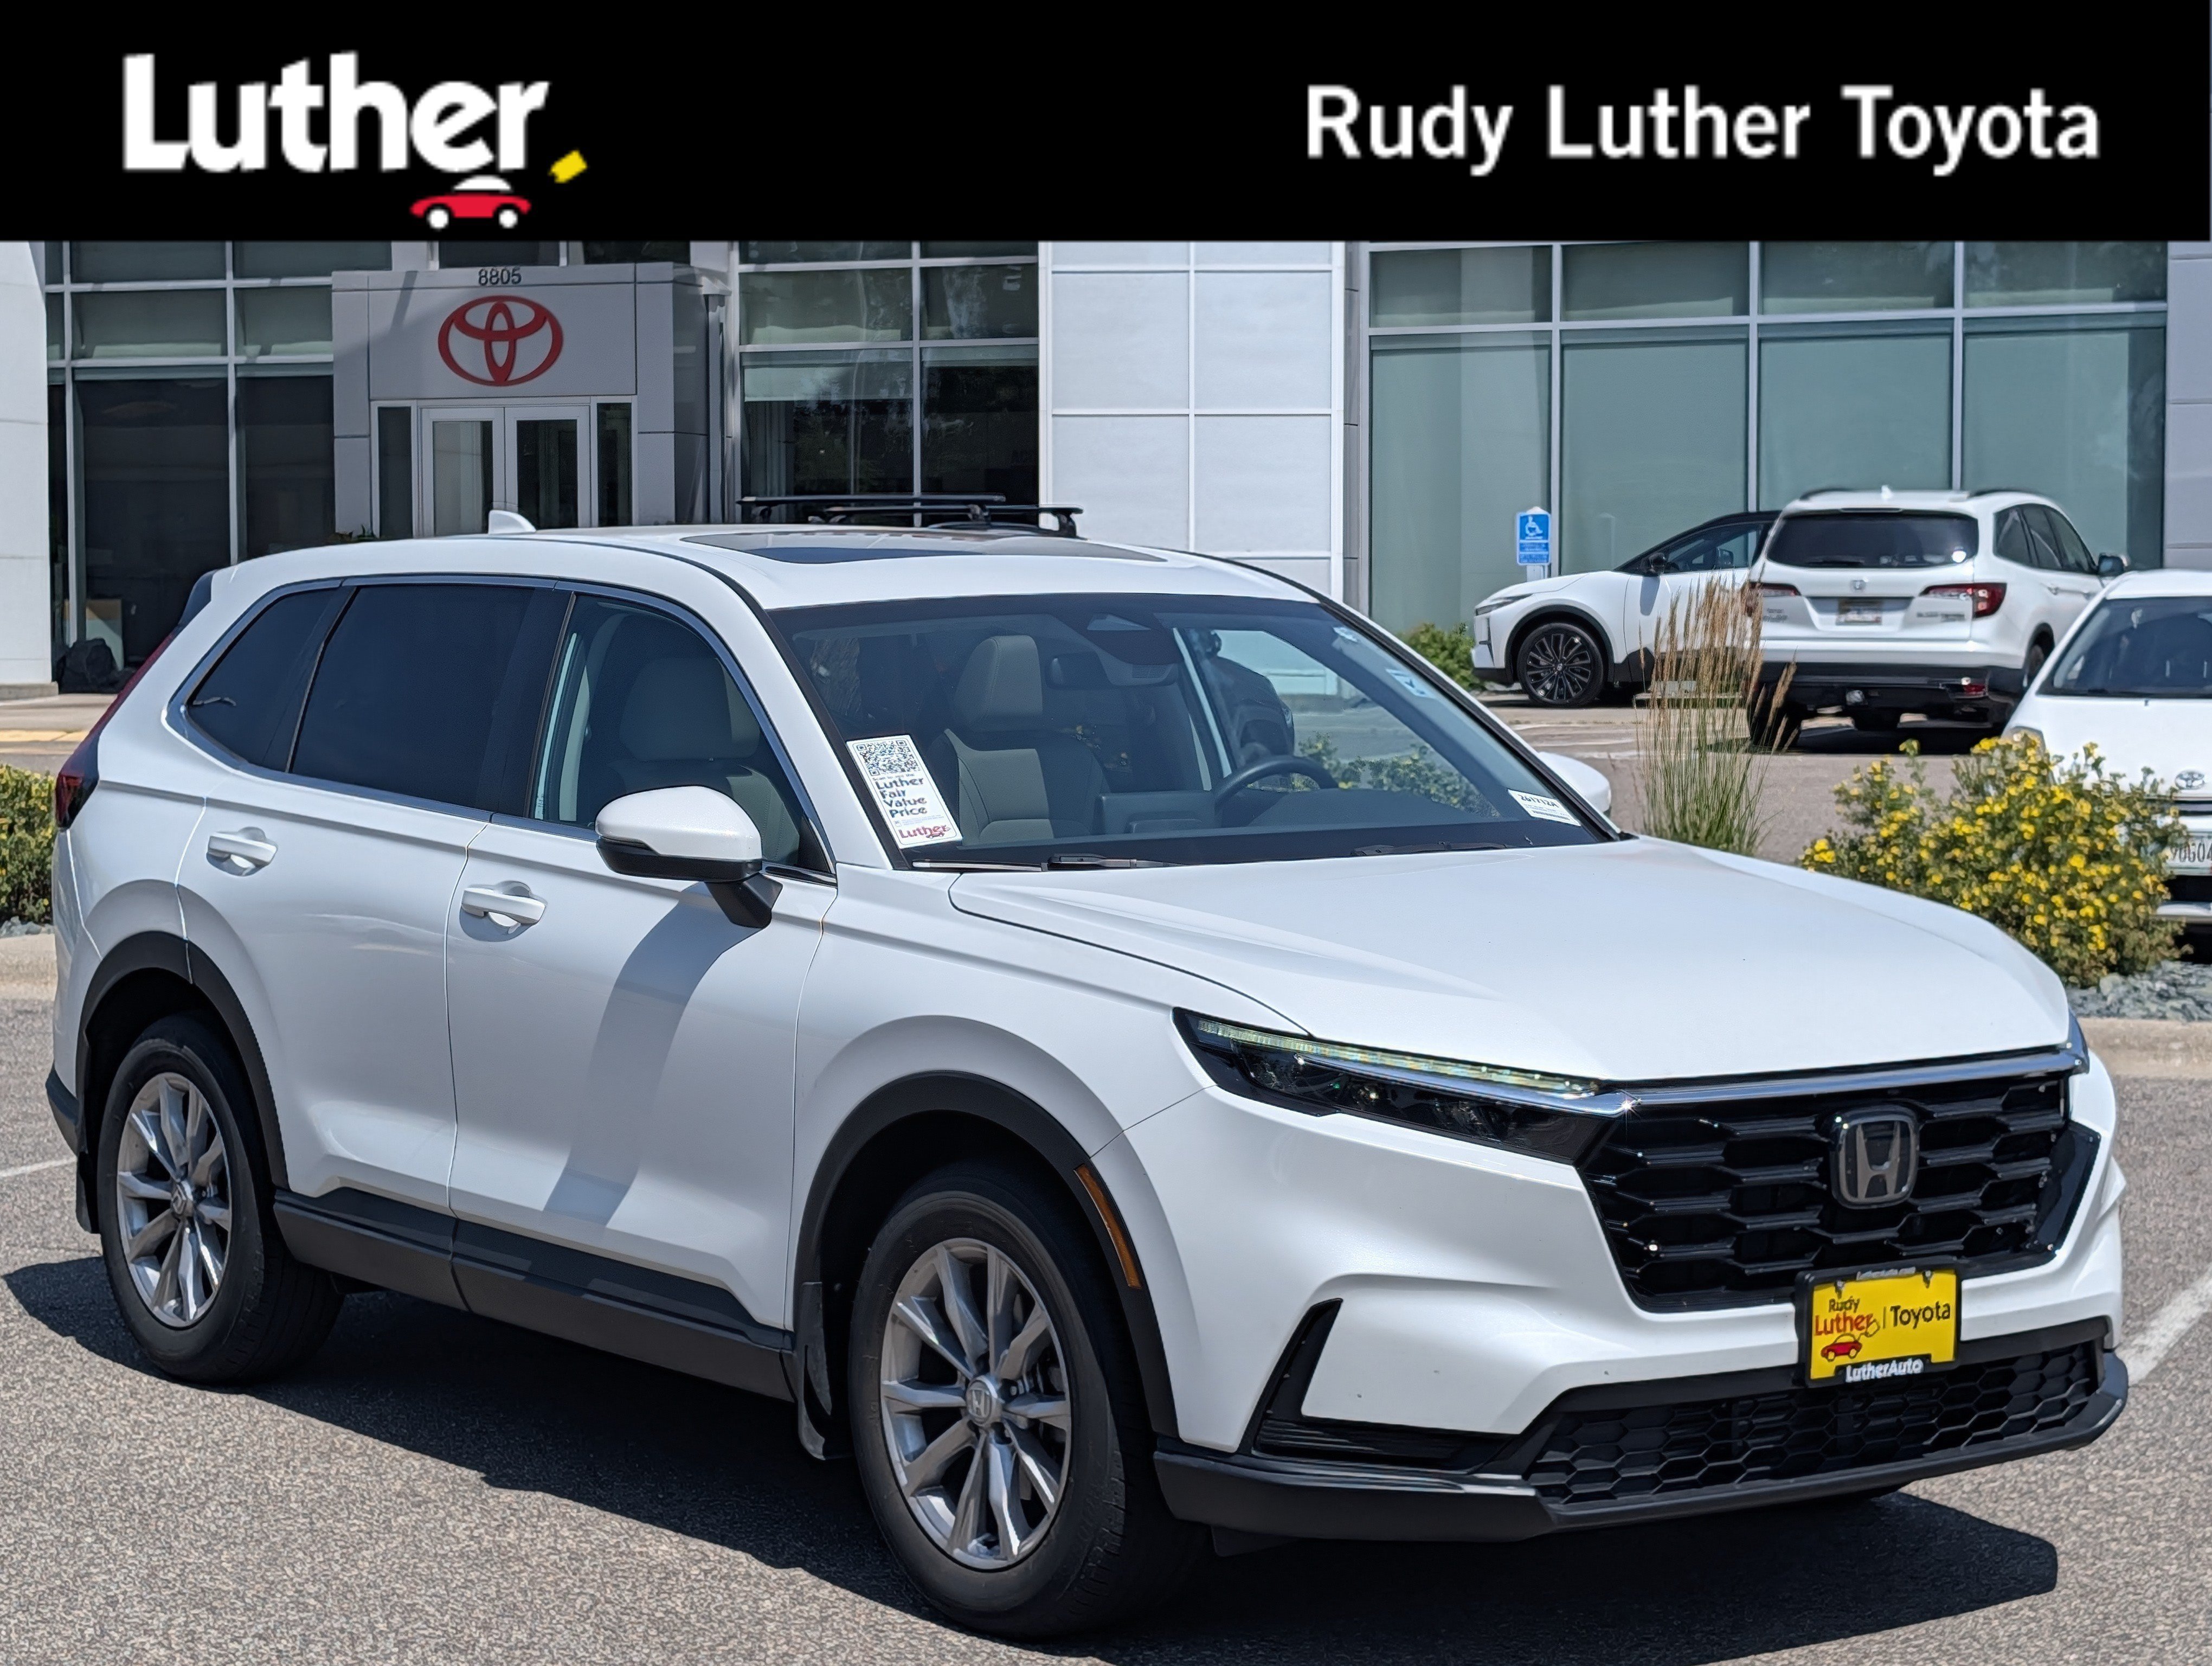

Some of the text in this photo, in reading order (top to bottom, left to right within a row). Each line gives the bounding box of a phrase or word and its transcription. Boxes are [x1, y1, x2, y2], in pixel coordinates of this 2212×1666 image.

[478, 267, 522, 286] 8805
[875, 778, 923, 790] Luther
[879, 788, 905, 799] Fair
[883, 797, 927, 808] Value
[889, 807, 927, 818] Price
[898, 824, 947, 838] Luther
[1828, 1295, 1861, 1313] Rudy
[1889, 1300, 1951, 1330] Toyota
[1815, 1311, 1874, 1336] Luther
[1846, 1358, 1924, 1383] LutherAuto
